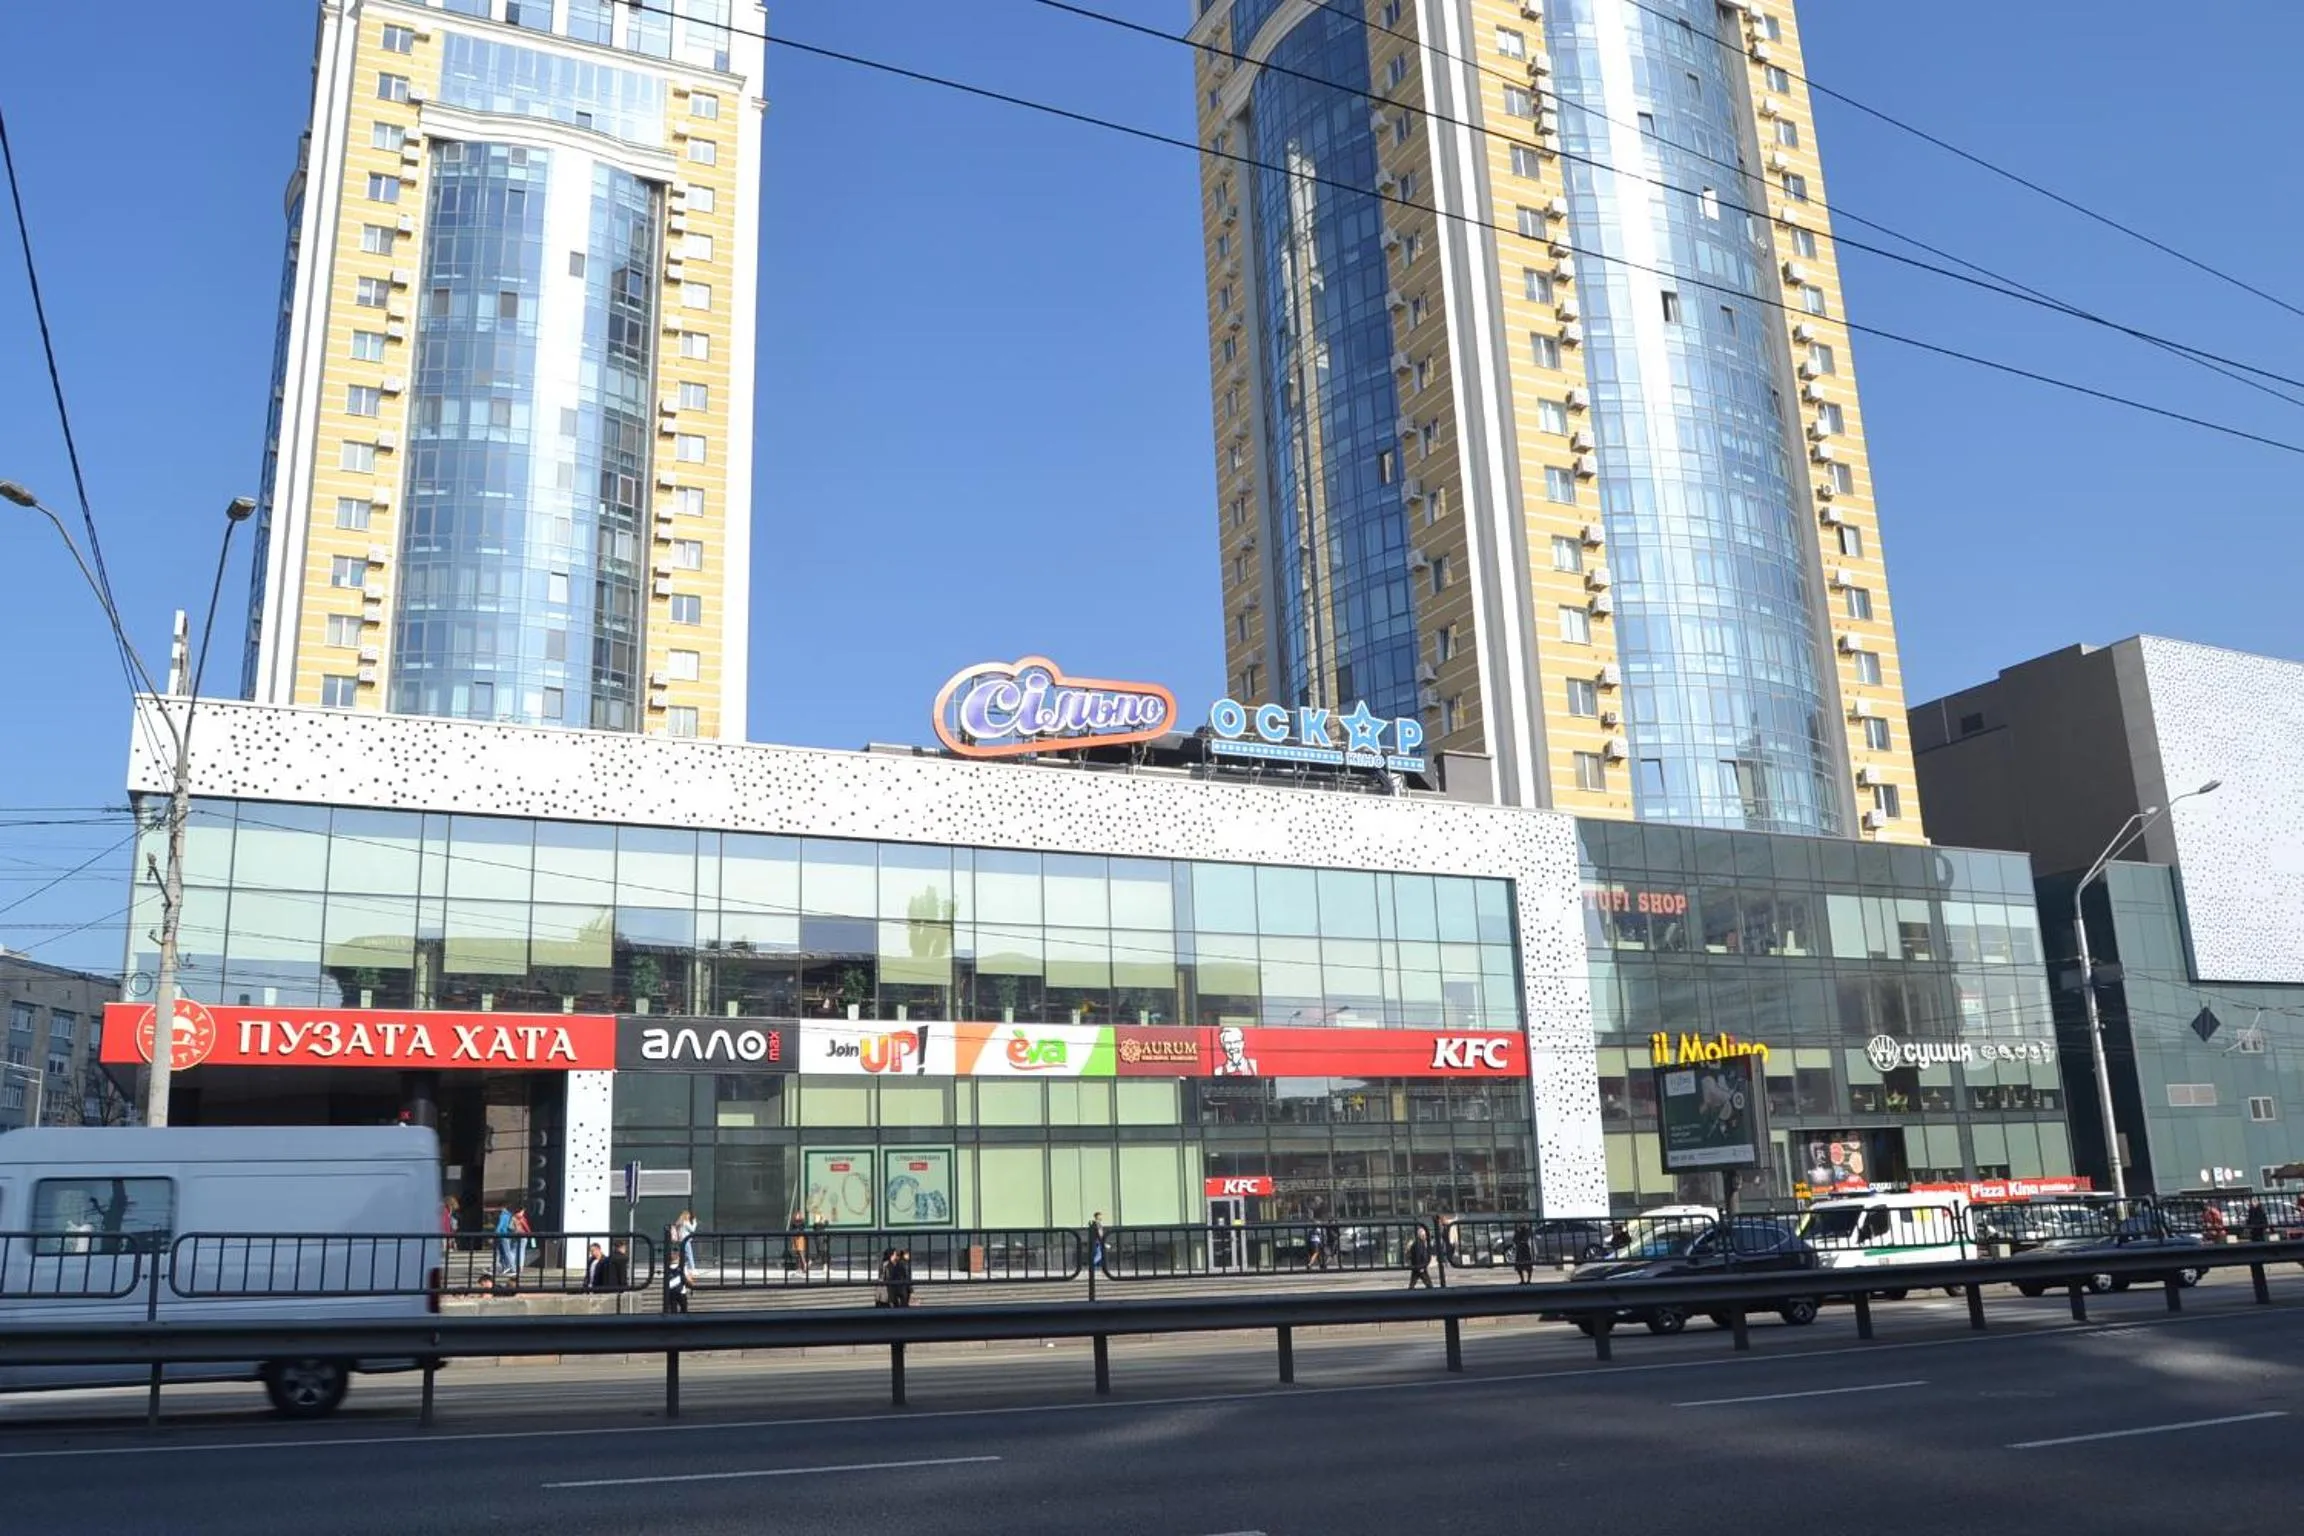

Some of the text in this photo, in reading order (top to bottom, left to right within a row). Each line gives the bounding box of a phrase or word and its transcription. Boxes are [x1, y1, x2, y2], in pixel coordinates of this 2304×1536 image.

[960, 673, 1167, 739] Сільпо
[1581, 890, 1688, 915] TUFI SHOP
[238, 1020, 578, 1061] ПУЗАТА ХАТА
[768, 1030, 782, 1062] max
[825, 1025, 929, 1076] Join UP!
[1007, 1035, 1067, 1063] eva
[1142, 1042, 1198, 1055] AURUM
[1432, 1037, 1509, 1069] KFC
[1652, 1031, 1670, 1064] il
[1903, 1042, 1973, 1069] сушия
[1223, 1178, 1260, 1194] KFC
[1970, 1182, 2005, 1198] Pizza
